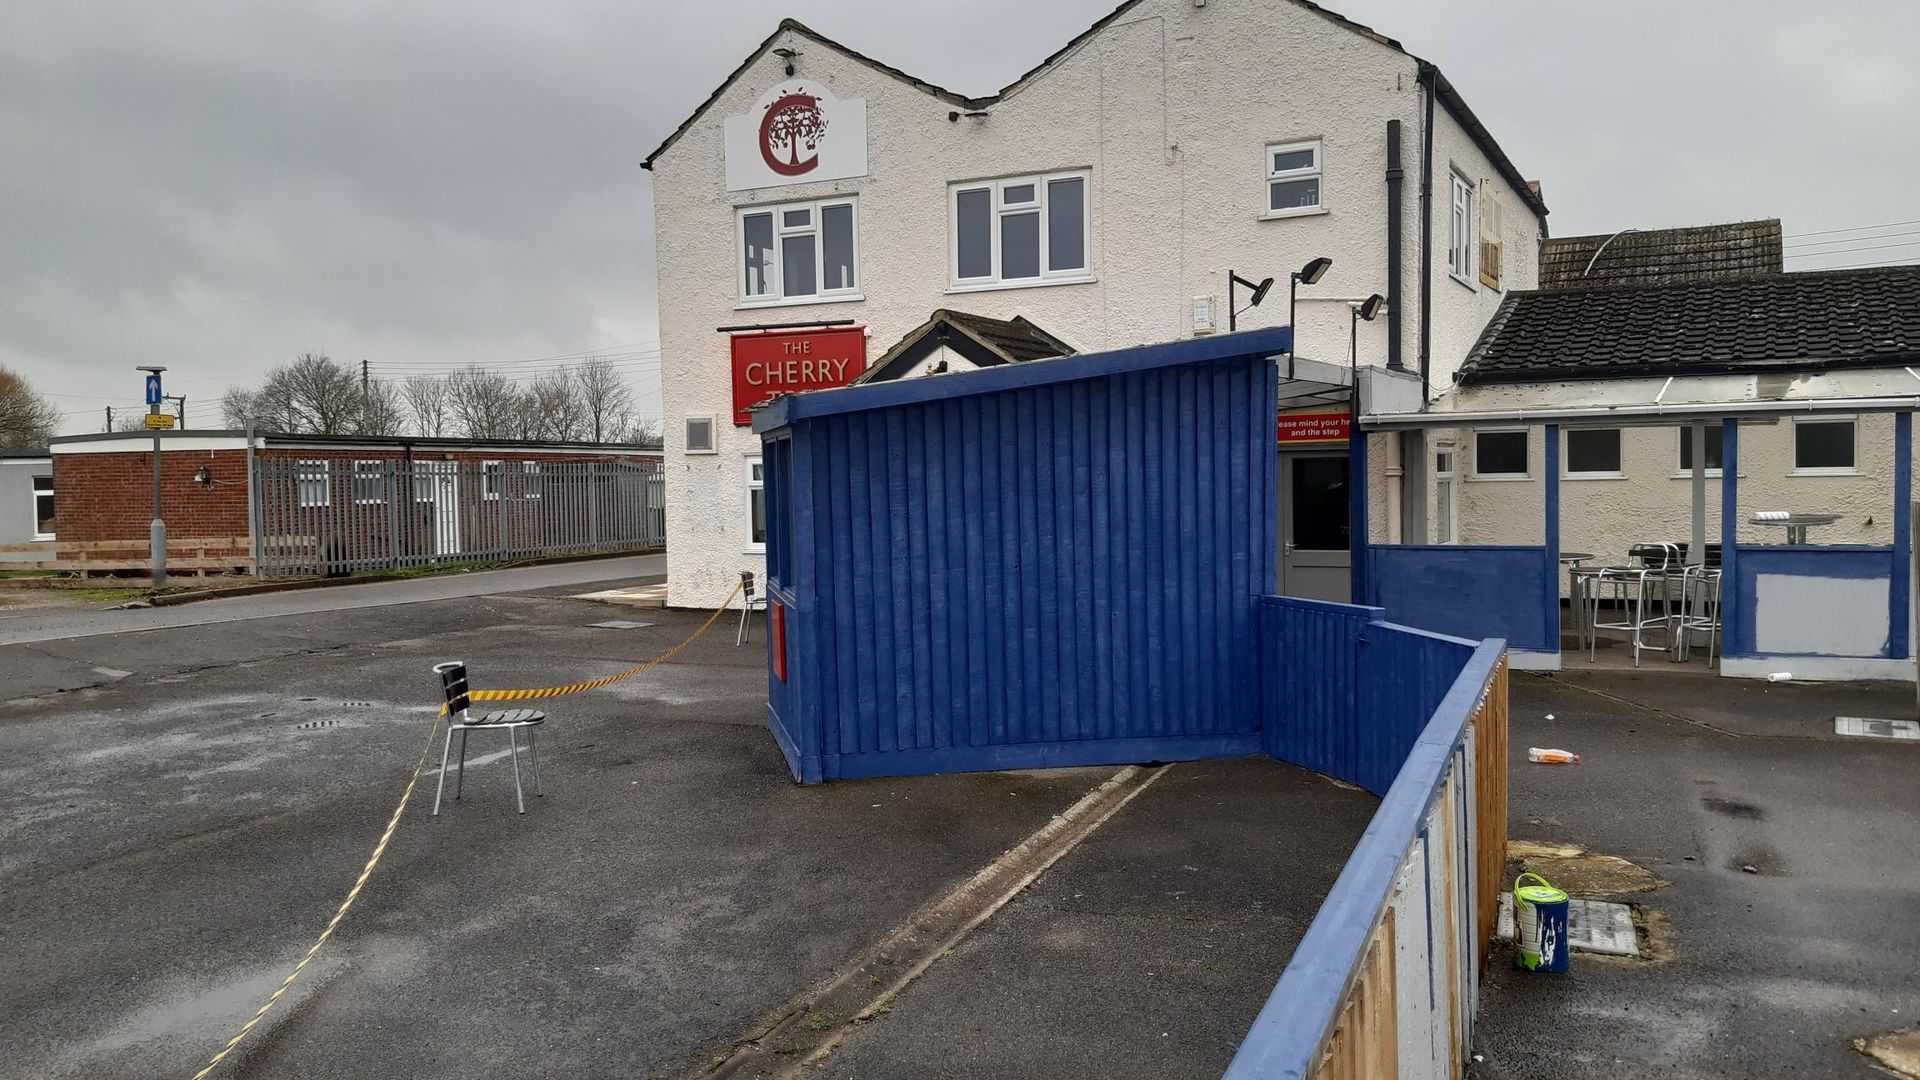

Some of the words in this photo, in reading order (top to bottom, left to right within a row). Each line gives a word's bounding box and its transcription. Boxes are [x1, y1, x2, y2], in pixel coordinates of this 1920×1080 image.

[783, 341, 812, 355] THE
[746, 358, 849, 386] CHERRY
[1278, 420, 1297, 428] ease
[1298, 419, 1319, 427] mind
[1320, 419, 1340, 428] your
[1340, 418, 1350, 426] he
[1291, 429, 1306, 437] and
[1307, 428, 1321, 436] the
[1322, 428, 1340, 437] step
